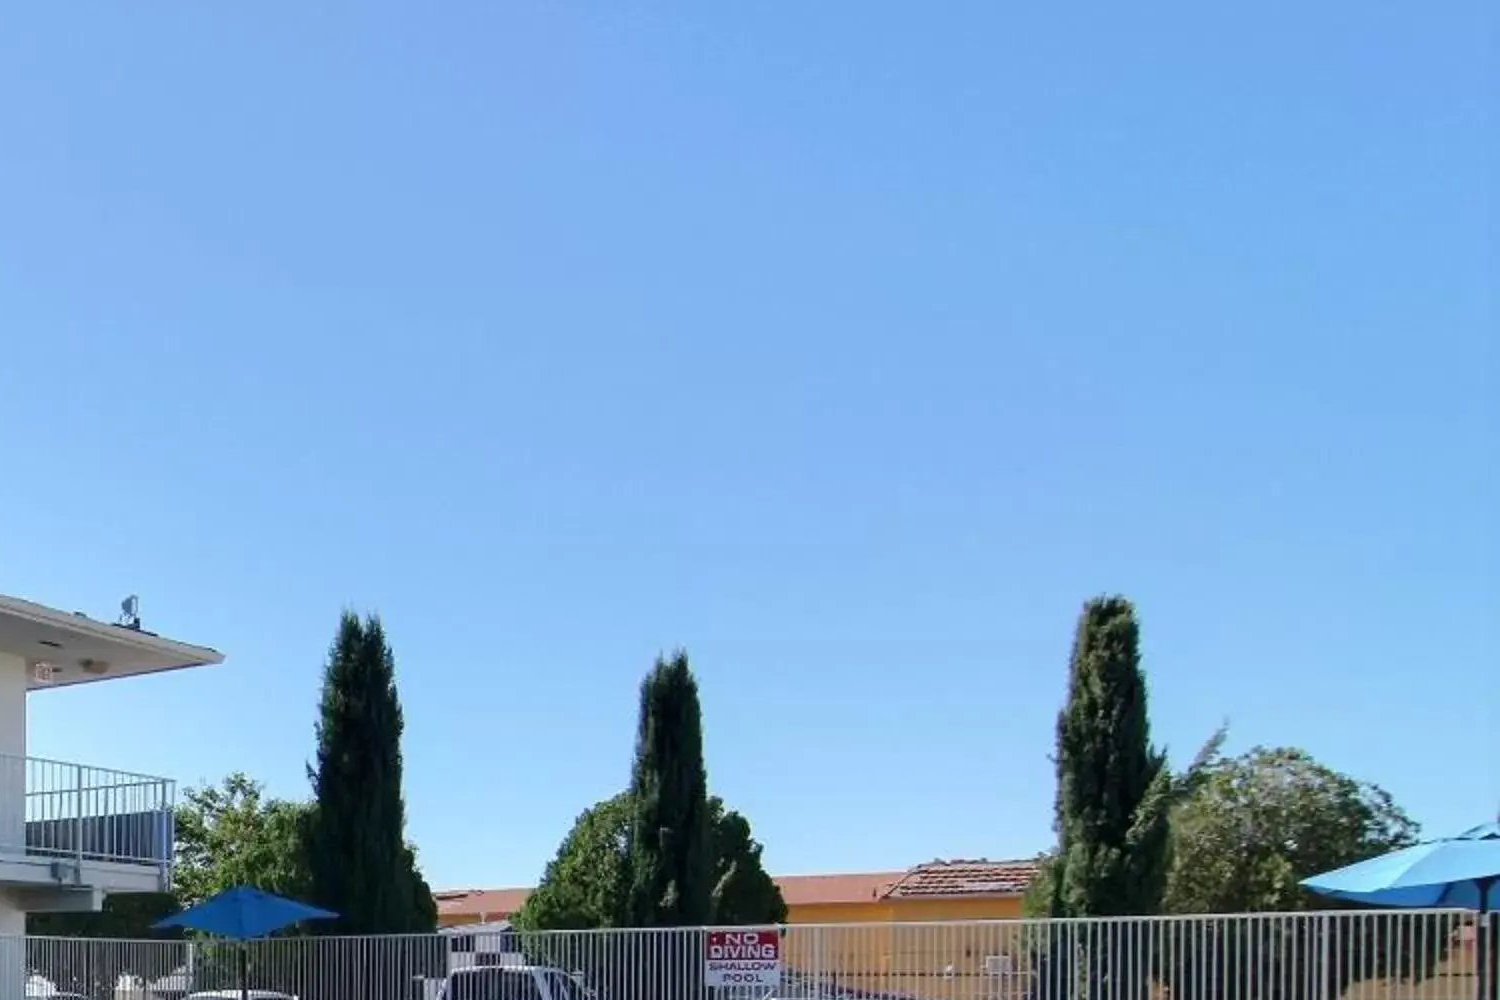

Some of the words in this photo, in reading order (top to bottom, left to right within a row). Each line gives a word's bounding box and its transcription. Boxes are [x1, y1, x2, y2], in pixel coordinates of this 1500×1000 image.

[725, 933, 759, 944] NO
[710, 944, 775, 958] DIVING
[709, 961, 777, 970] SHALLOW
[723, 974, 764, 982] POOL
